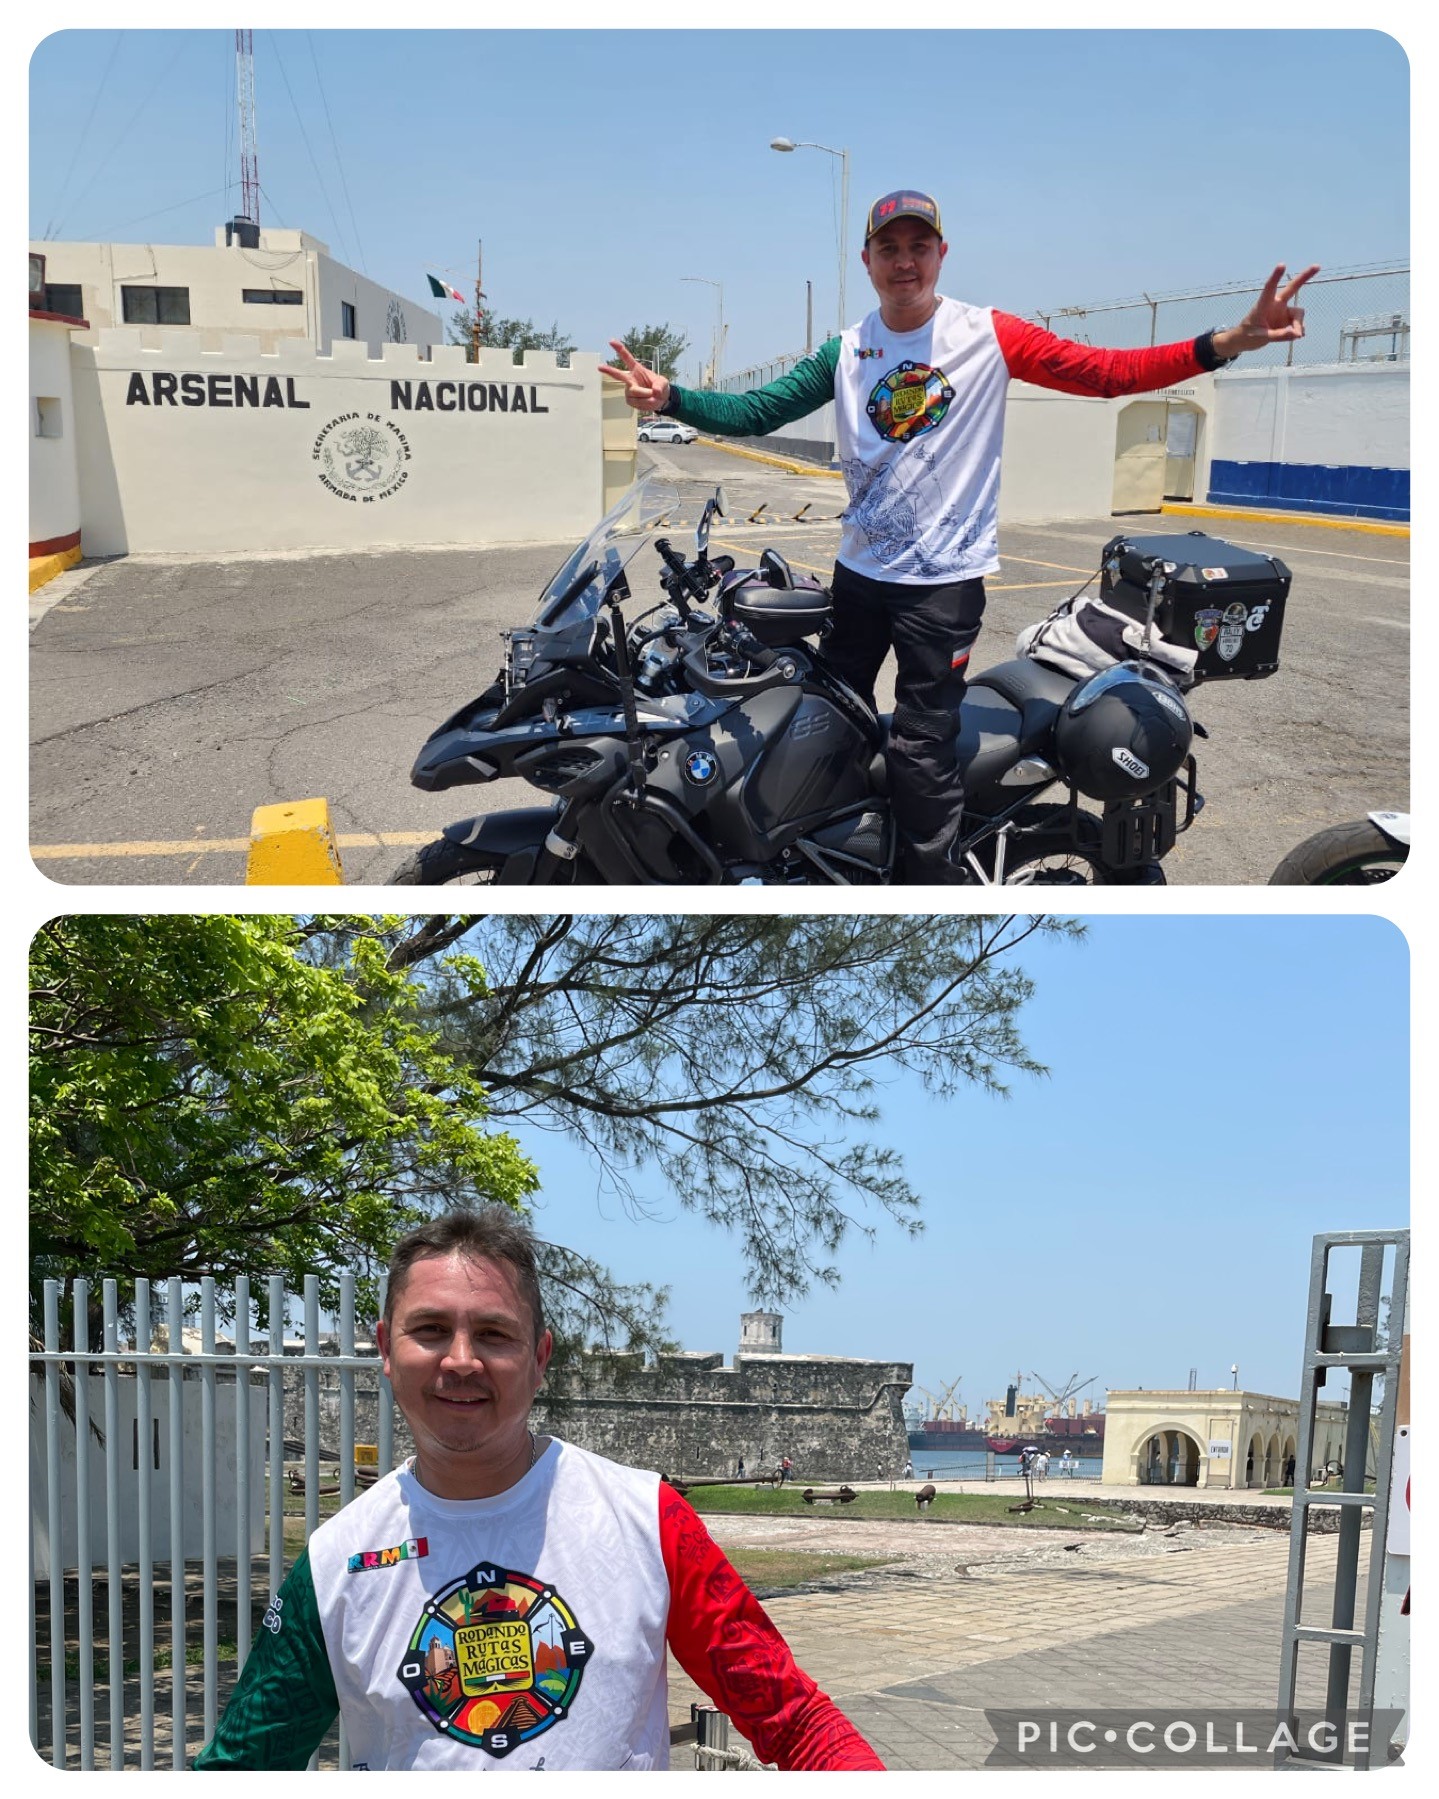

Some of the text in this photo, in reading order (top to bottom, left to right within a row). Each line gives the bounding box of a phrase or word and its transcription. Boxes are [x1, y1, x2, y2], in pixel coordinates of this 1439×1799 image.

[126, 372, 549, 413] ARSENAL NACIONAL
[312, 412, 412, 461] SECRETARIA DE MARINA
[318, 471, 409, 503] ARMADA DE MEXICO
[1117, 752, 1146, 776] SHOEI
[349, 1547, 401, 1569] RRM
[476, 1570, 496, 1584] N
[569, 1640, 586, 1655] E
[403, 1663, 421, 1678] O
[491, 1733, 508, 1749] S
